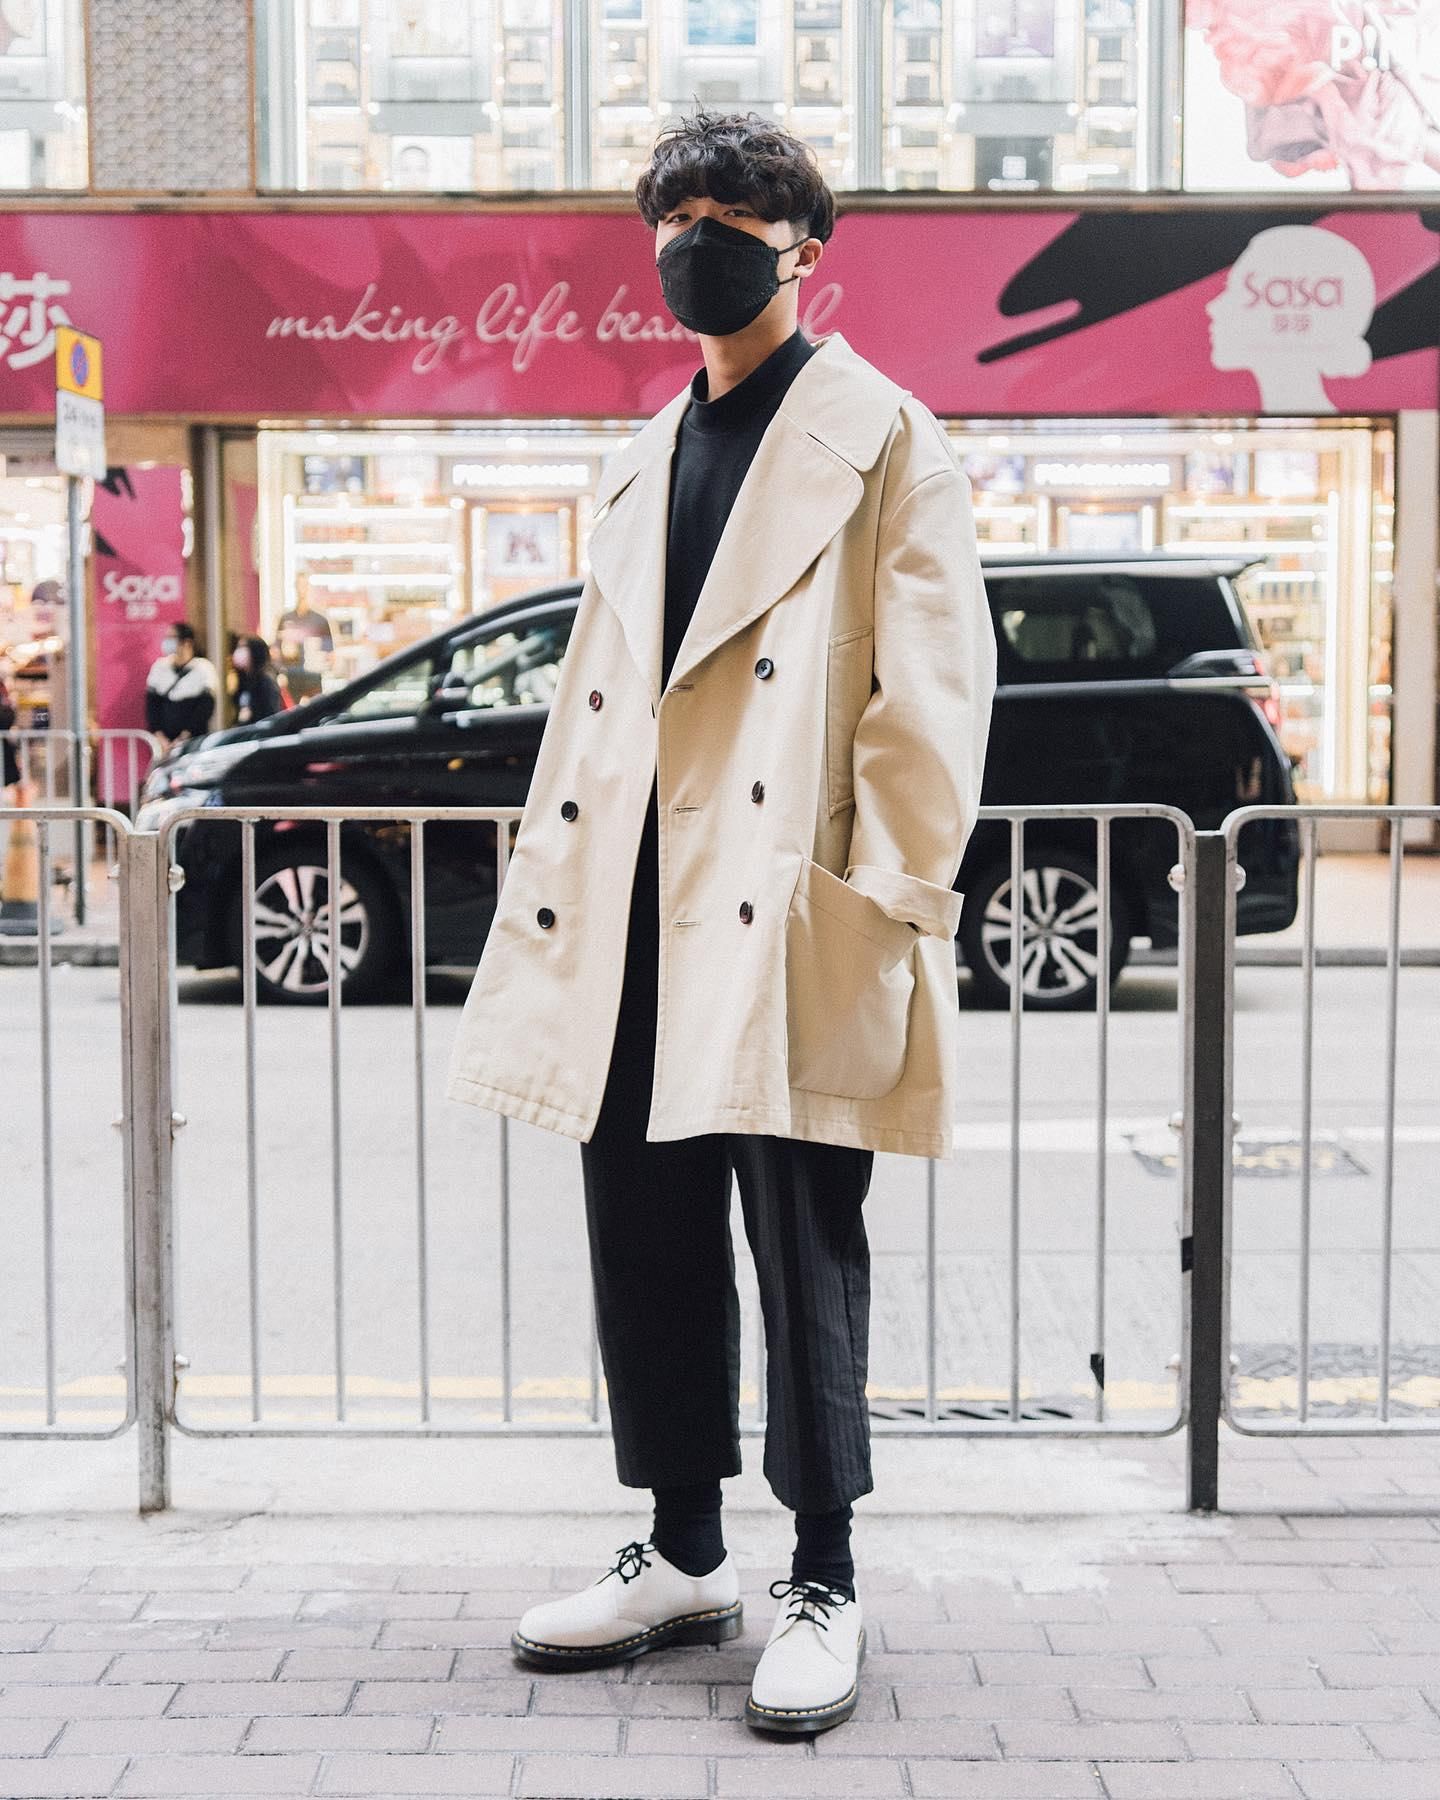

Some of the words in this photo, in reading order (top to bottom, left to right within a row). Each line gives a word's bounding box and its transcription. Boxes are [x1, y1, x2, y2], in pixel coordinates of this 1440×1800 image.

[1244, 272, 1344, 309] Sasa
[266, 283, 465, 374] making
[476, 281, 583, 373] life
